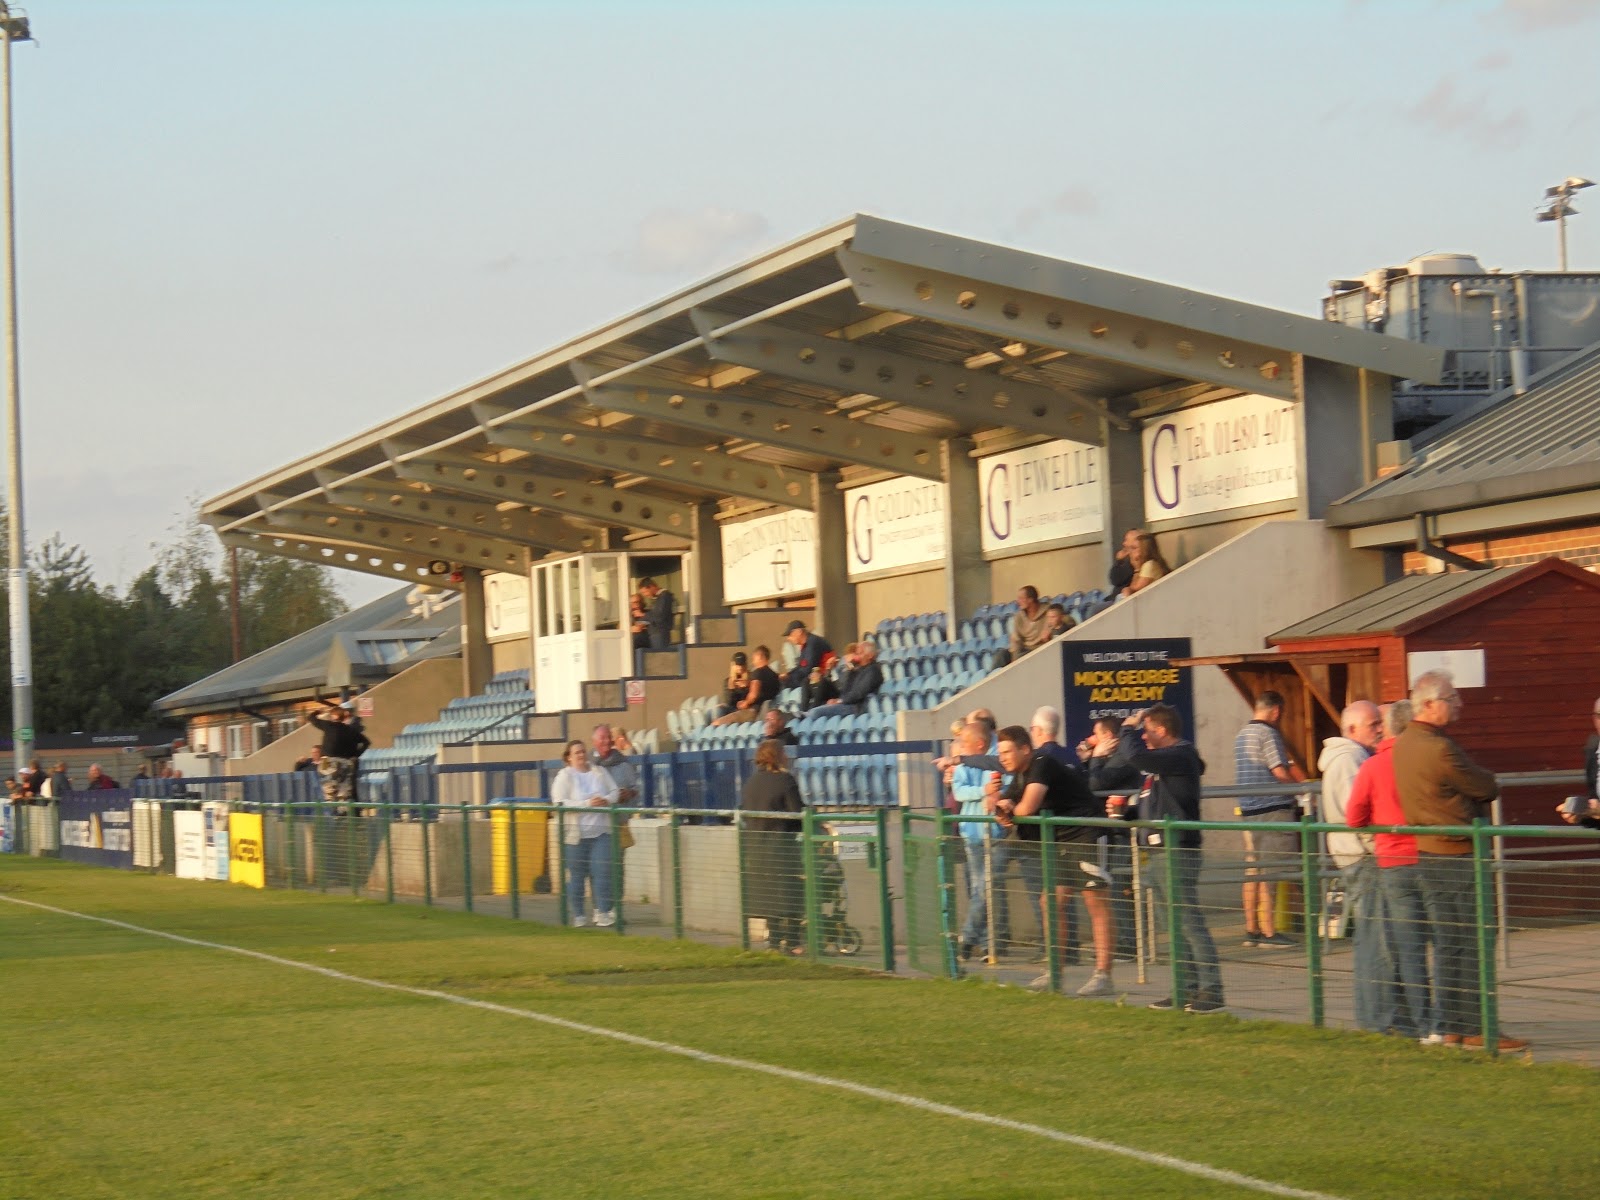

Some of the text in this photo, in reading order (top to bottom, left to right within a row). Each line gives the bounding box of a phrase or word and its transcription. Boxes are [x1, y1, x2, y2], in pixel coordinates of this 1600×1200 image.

[1082, 651, 1169, 663] WELCOME TO THE
[1074, 668, 1180, 686] MICK GEORGE
[1089, 686, 1167, 703] ACADEMY
